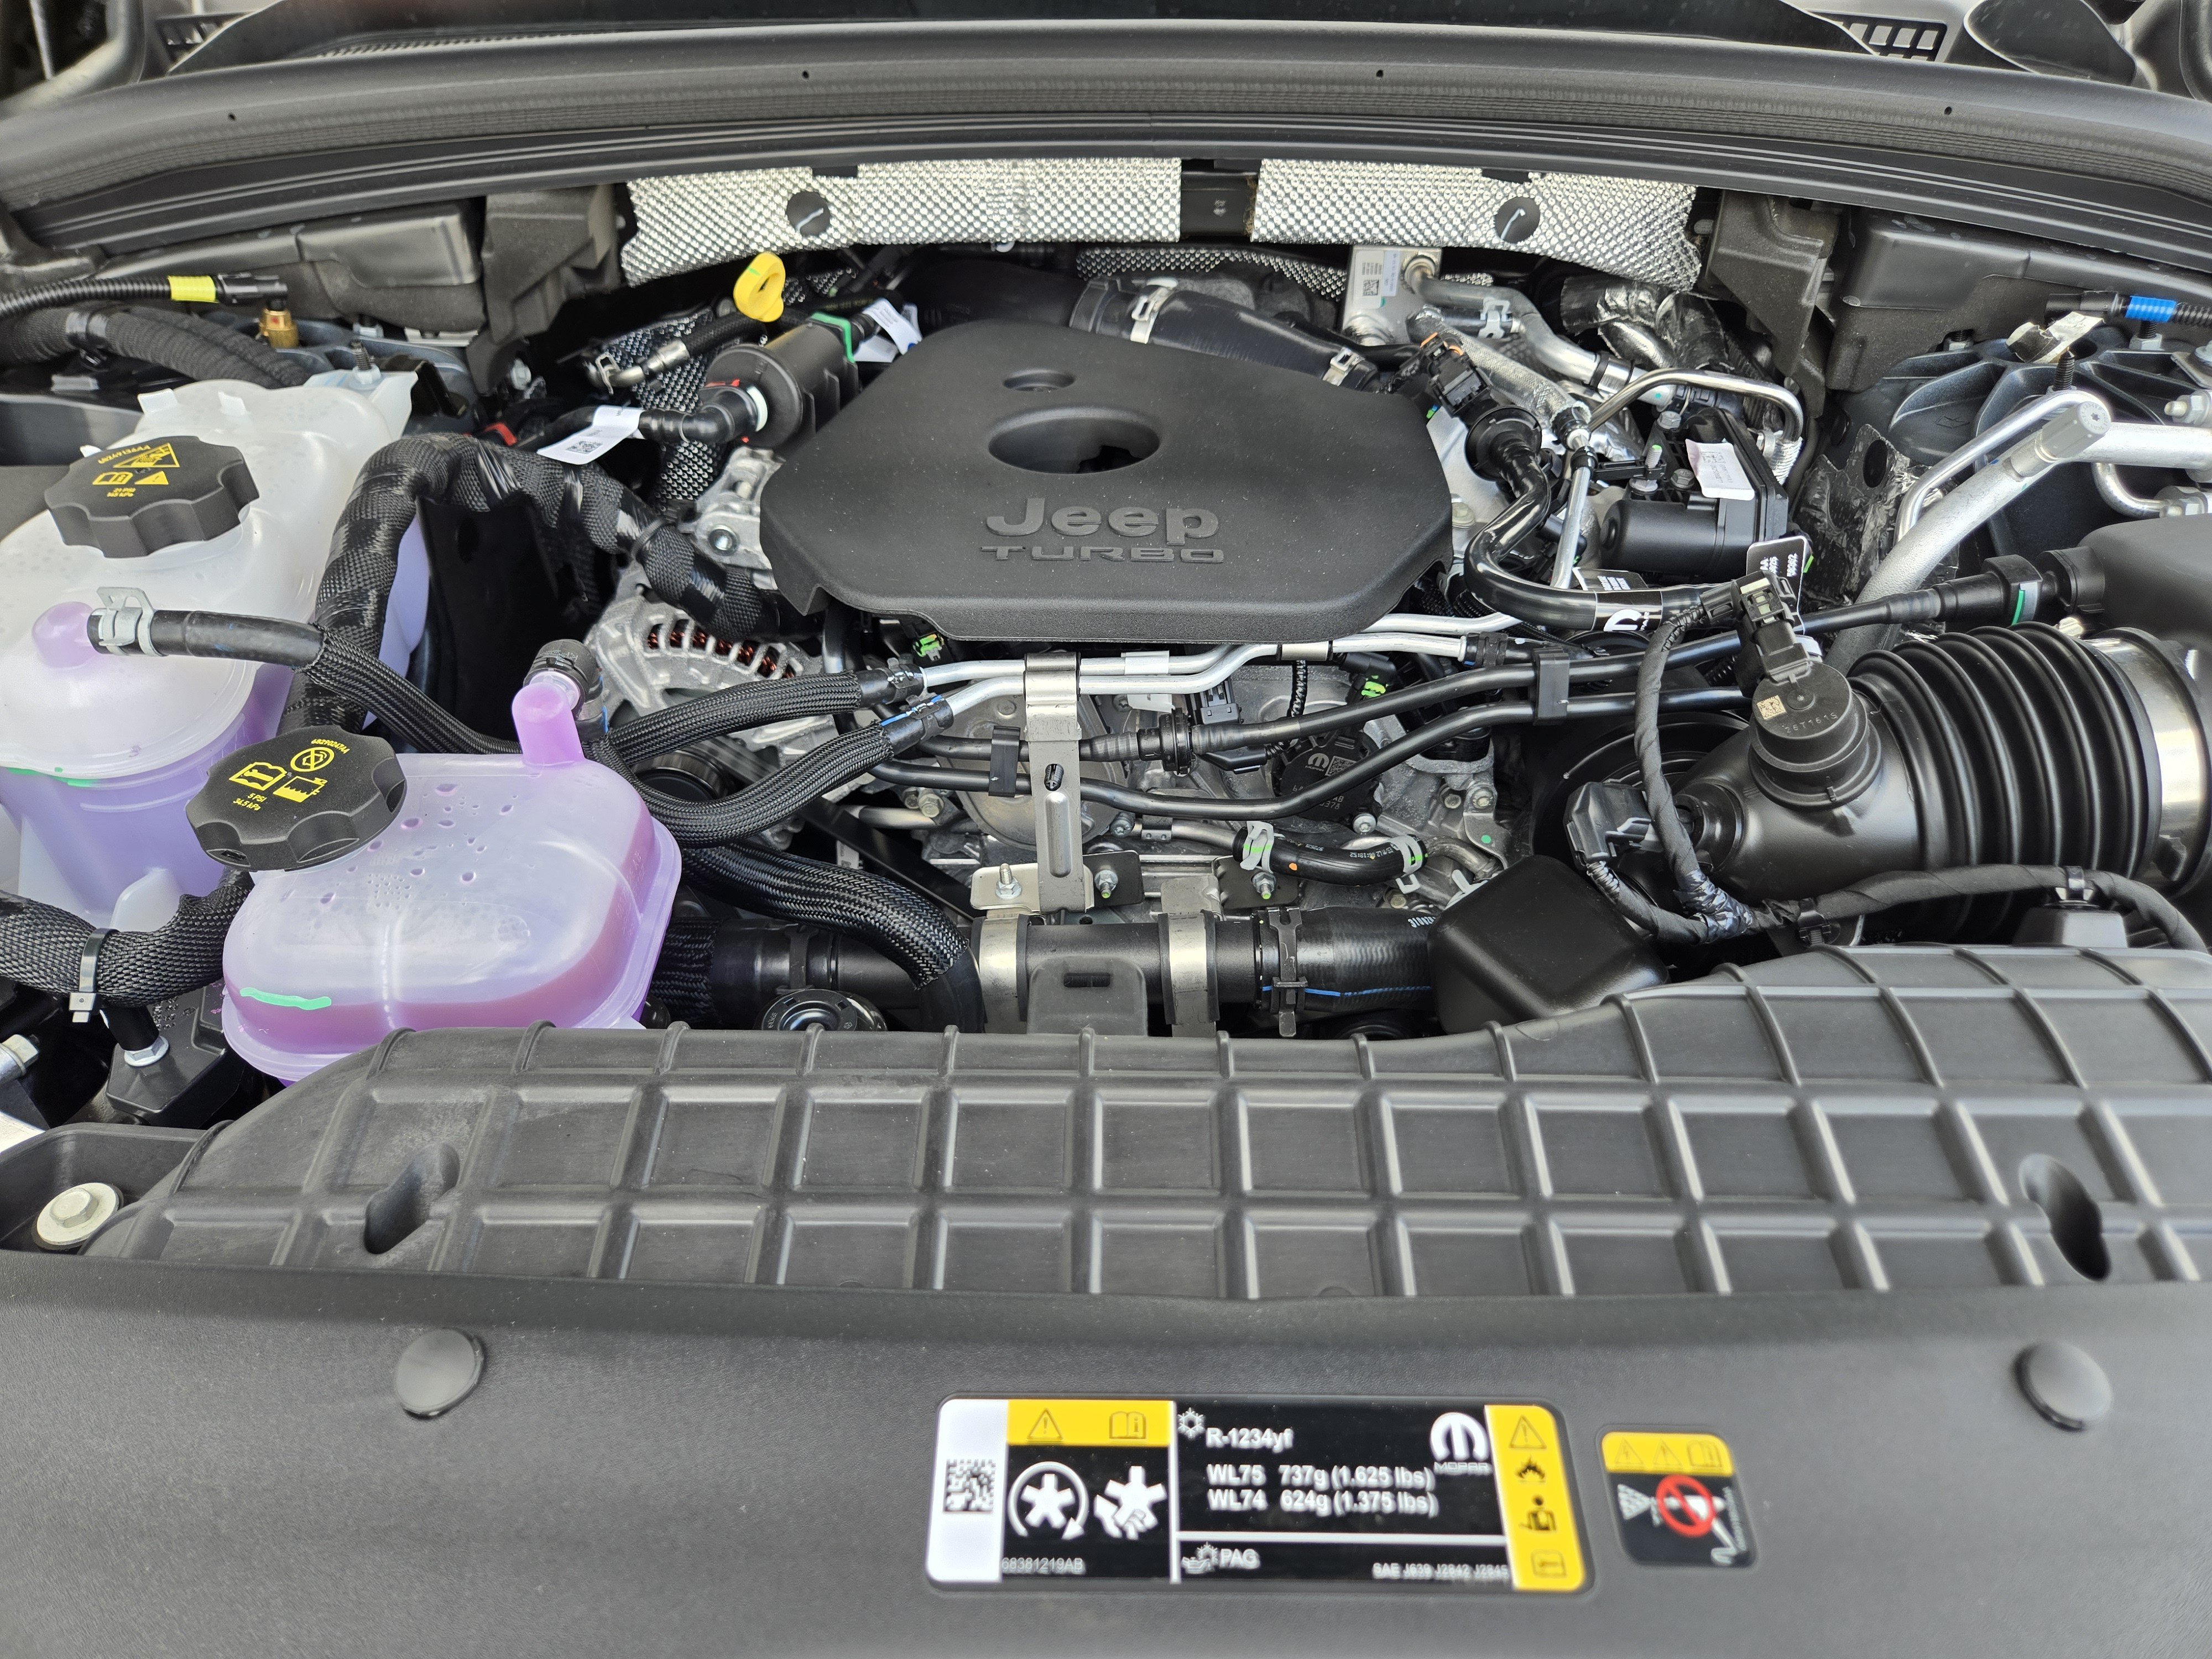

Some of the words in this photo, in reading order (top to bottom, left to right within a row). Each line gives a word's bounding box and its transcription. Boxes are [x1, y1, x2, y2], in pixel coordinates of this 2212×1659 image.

[986, 498, 1218, 545] Jeep
[980, 546, 1224, 563] TURBO
[233, 798, 249, 806] 34.5
[247, 801, 261, 811] kPa
[254, 794, 267, 802] PSI
[1206, 1427, 1294, 1453] R-1234yf
[1433, 1461, 1492, 1475] MOPAR
[1206, 1464, 1266, 1486] WL75
[1279, 1464, 1329, 1491] 737g
[1331, 1465, 1390, 1491] (1.625
[1394, 1465, 1436, 1491] lbs)
[1207, 1489, 1267, 1511] WL74
[1280, 1489, 1332, 1517] 624g
[1333, 1490, 1395, 1516] (1.375
[1396, 1490, 1439, 1518] lbs)
[1001, 1557, 1086, 1575] 68381219AB
[1219, 1548, 1261, 1569] PAG
[1372, 1562, 1402, 1579] SAE
